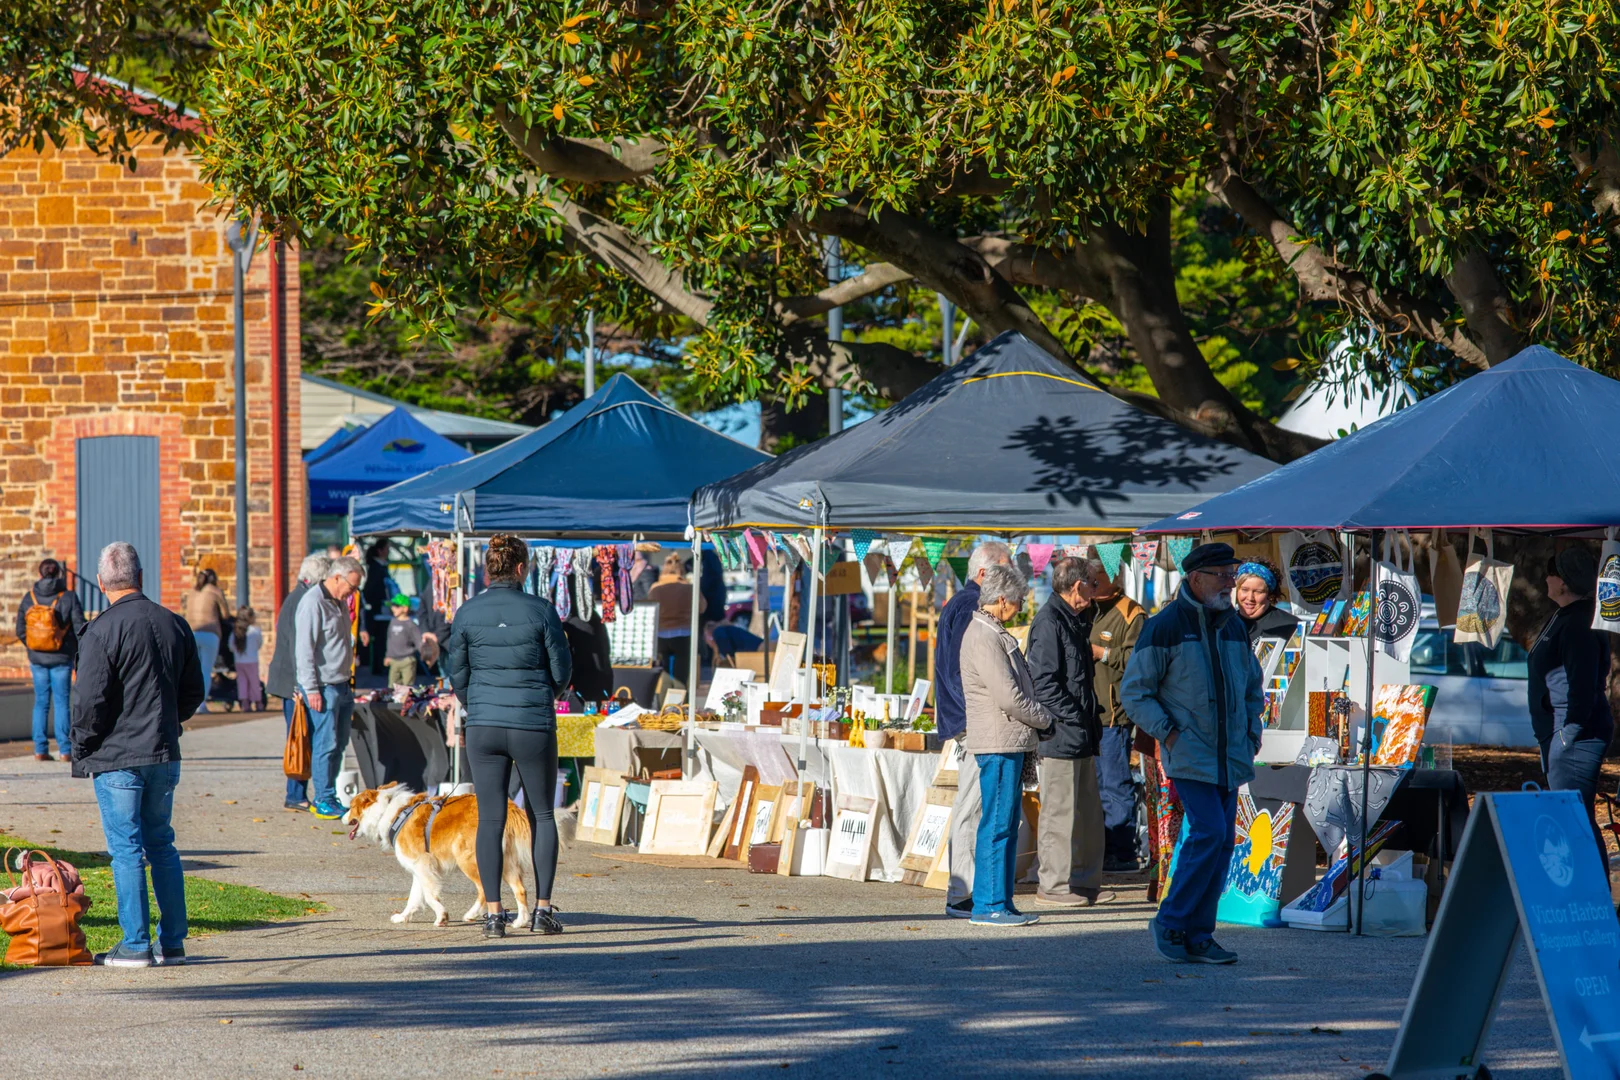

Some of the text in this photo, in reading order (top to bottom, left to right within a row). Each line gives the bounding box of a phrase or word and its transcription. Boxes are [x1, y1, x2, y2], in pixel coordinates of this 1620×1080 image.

[1531, 902, 1610, 924] Victor Harbor
[1540, 929, 1617, 952] Regional Gallery
[1575, 975, 1610, 997] OPEN
